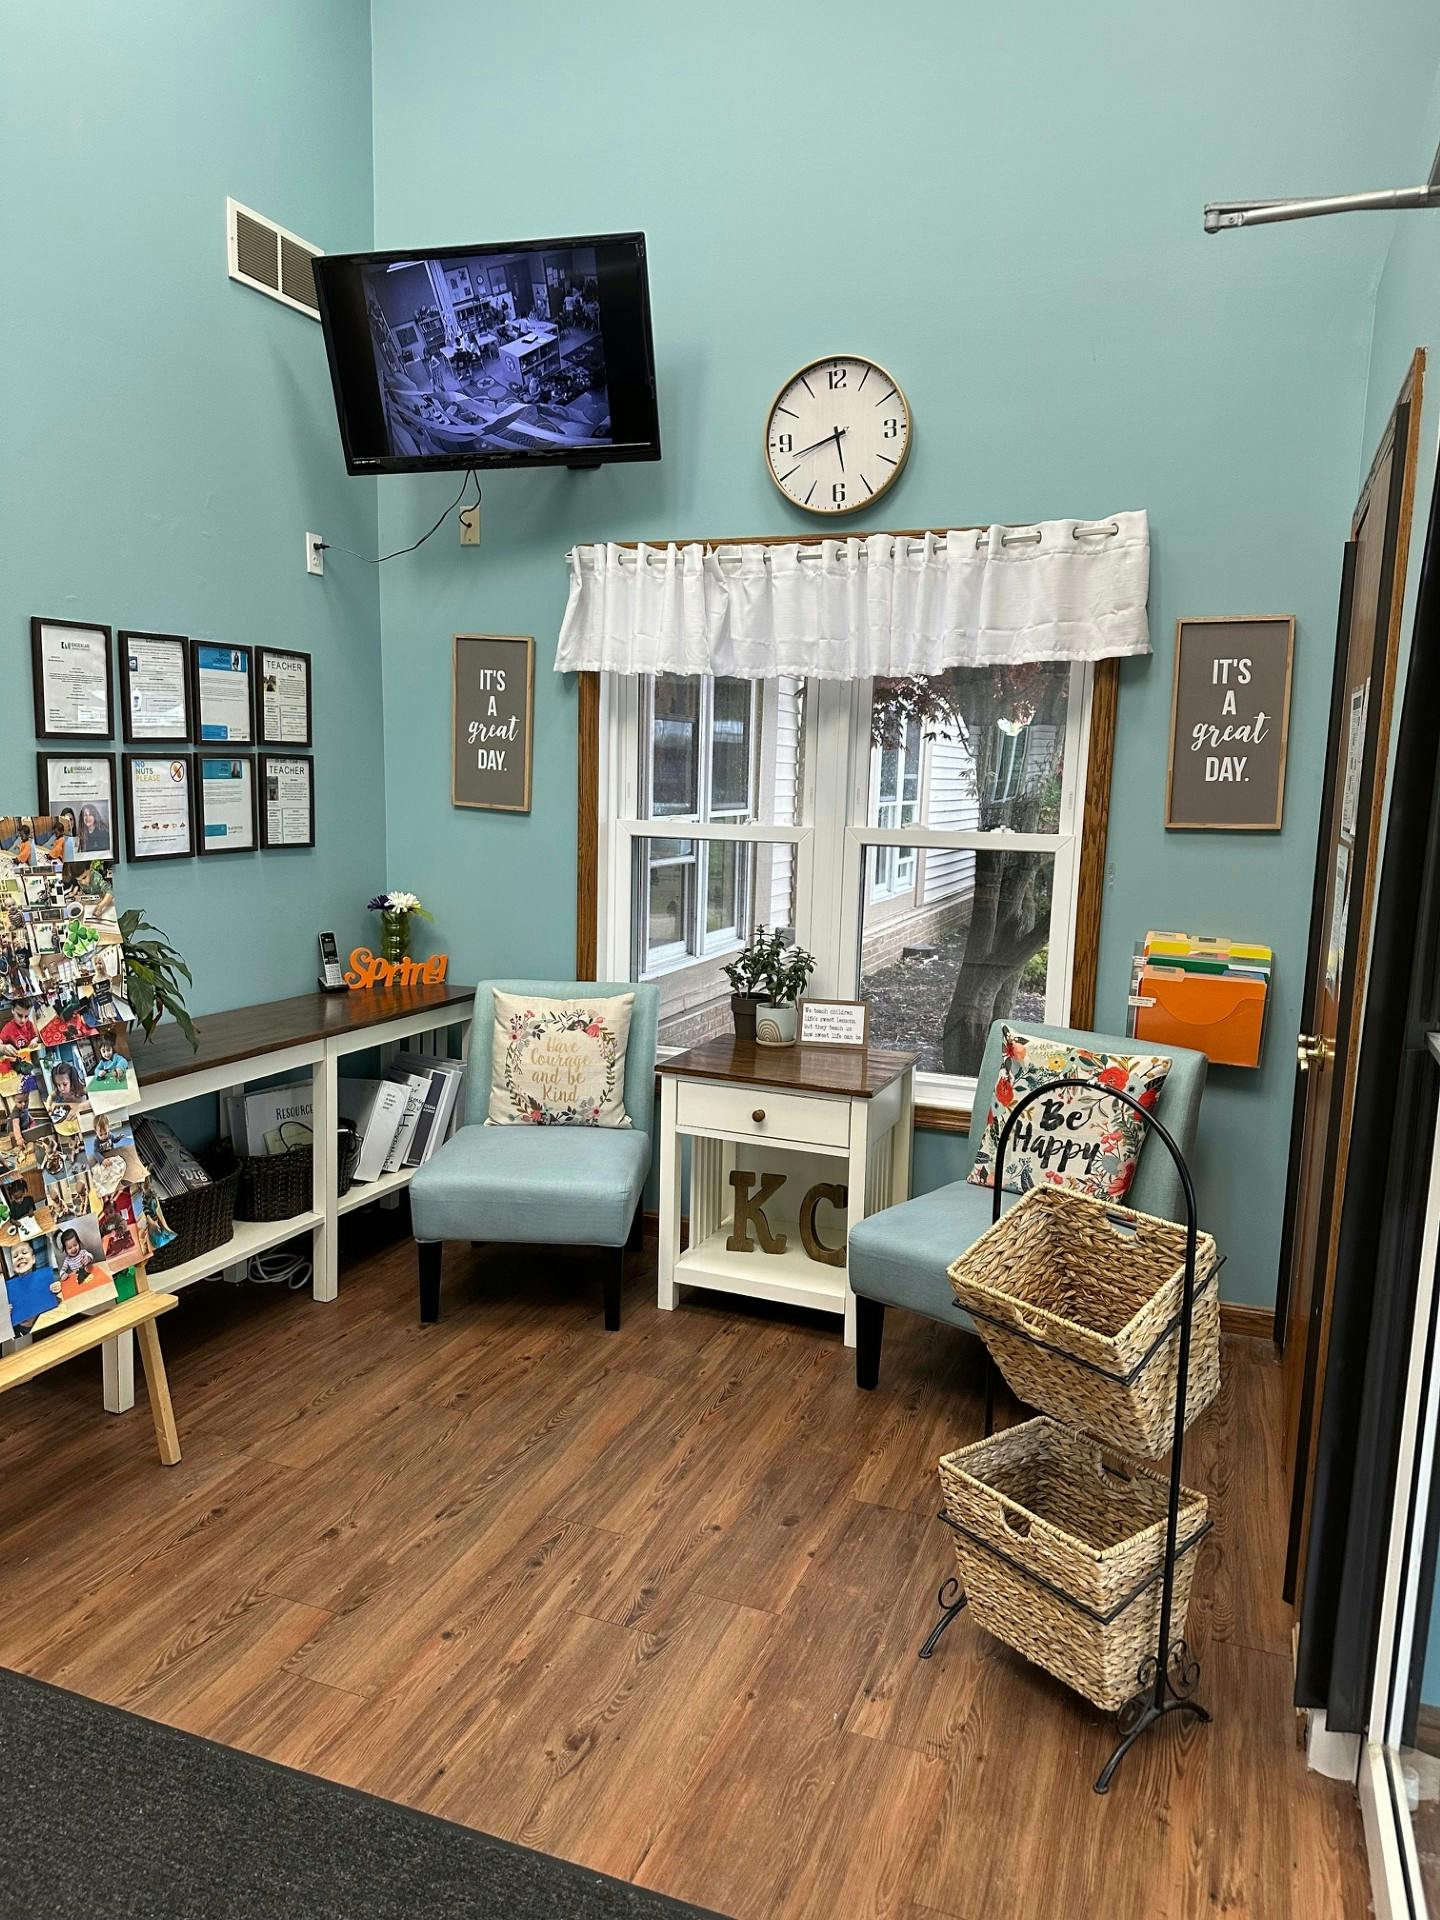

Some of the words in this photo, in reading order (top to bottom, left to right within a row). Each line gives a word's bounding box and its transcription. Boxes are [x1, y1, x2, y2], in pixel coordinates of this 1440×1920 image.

[826, 369, 847, 390] 12
[884, 418, 897, 438] 3
[779, 434, 793, 453] 9
[832, 483, 846, 502] 6
[266, 660, 302, 672] TEACHER
[1212, 658, 1252, 684] IT'S
[479, 669, 506, 692] IT'S
[487, 695, 497, 716] A
[1221, 690, 1237, 715] A
[467, 714, 521, 744] great
[1190, 711, 1272, 751] great
[135, 760, 145, 768] NO
[269, 765, 305, 775] TEACHER
[478, 748, 508, 772] DAY.
[1205, 756, 1250, 782] DAY.
[135, 774, 161, 782] PLEASE
[343, 946, 448, 990] Spring
[545, 1036, 580, 1053] Have
[531, 1047, 592, 1073] Courage
[532, 1067, 561, 1085] and
[568, 1066, 585, 1085] be
[543, 1084, 579, 1103] Kind
[1040, 1098, 1089, 1131] Be
[1013, 1120, 1101, 1174] Happy
